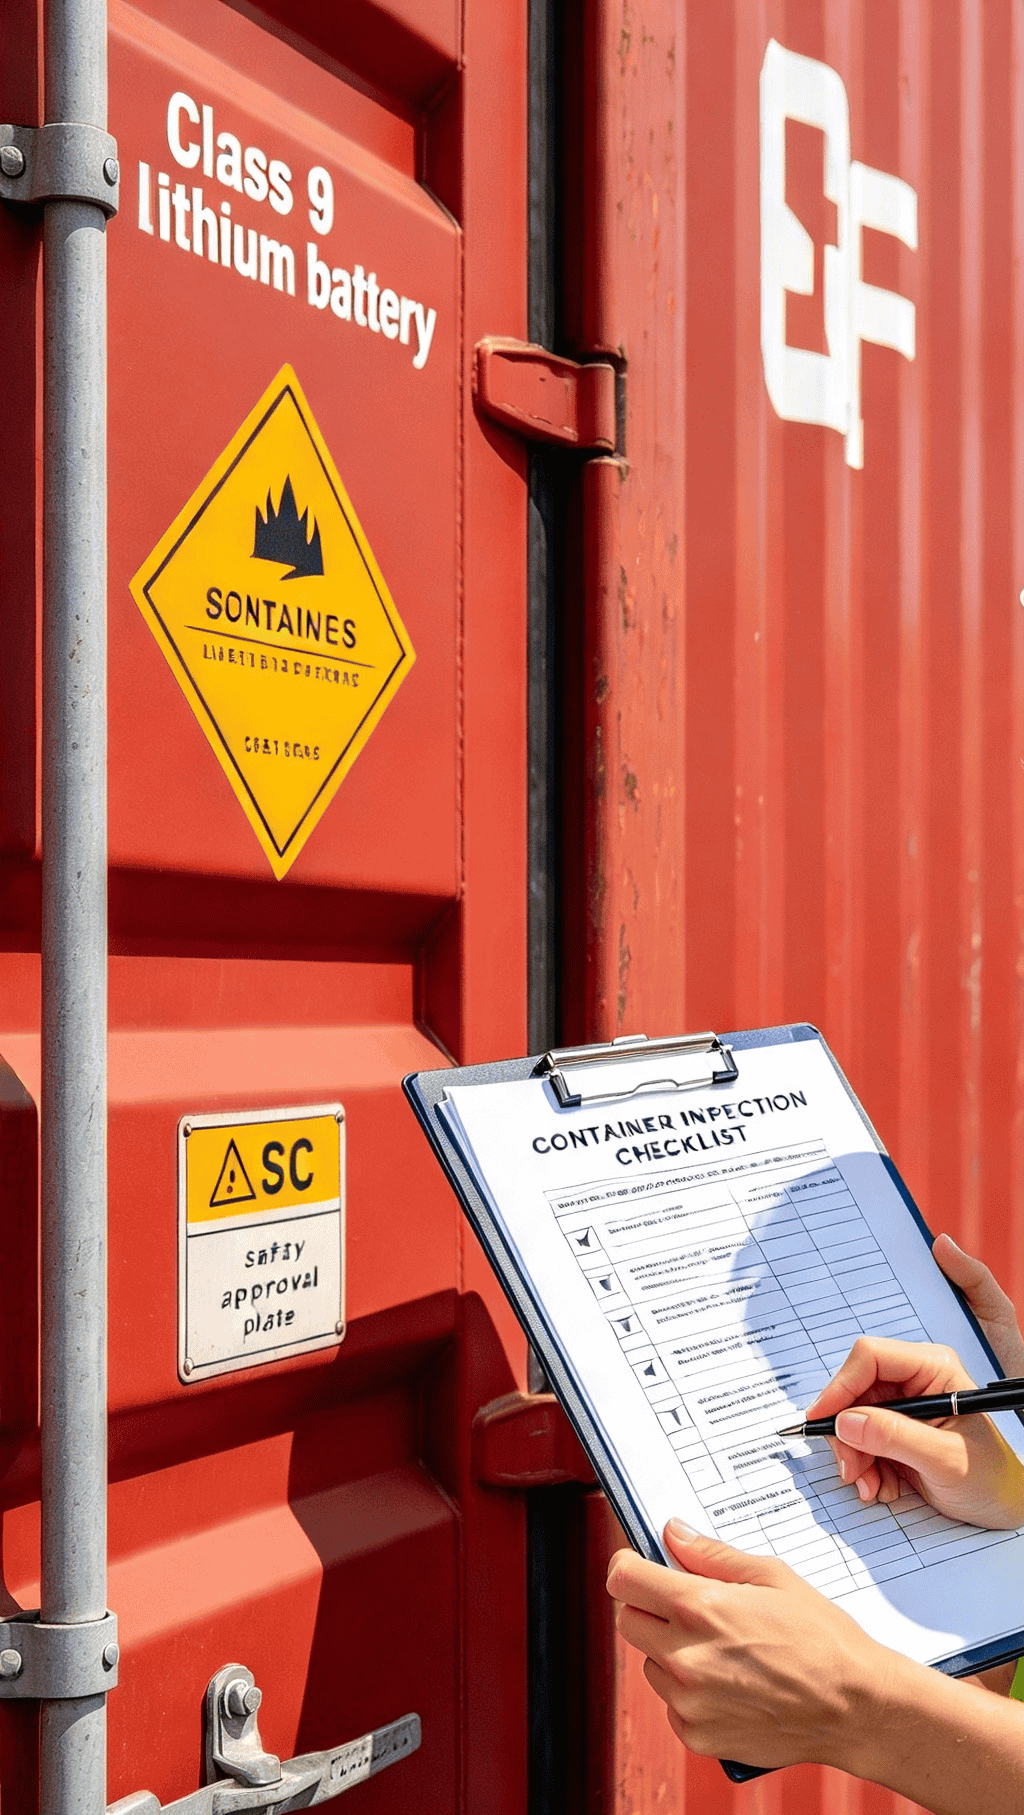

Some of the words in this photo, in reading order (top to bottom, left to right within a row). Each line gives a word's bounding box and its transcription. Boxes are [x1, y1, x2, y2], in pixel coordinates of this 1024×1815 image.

[166, 91, 294, 216] Class
[307, 166, 335, 236] 9
[306, 241, 437, 370] battery
[205, 586, 357, 649] SONTAINES
[531, 1114, 675, 1155] CONTAINER
[615, 1125, 748, 1166] CHECKLIST
[261, 1137, 314, 1195] SC
[221, 1265, 318, 1310] approval
[243, 1309, 295, 1344] plate
